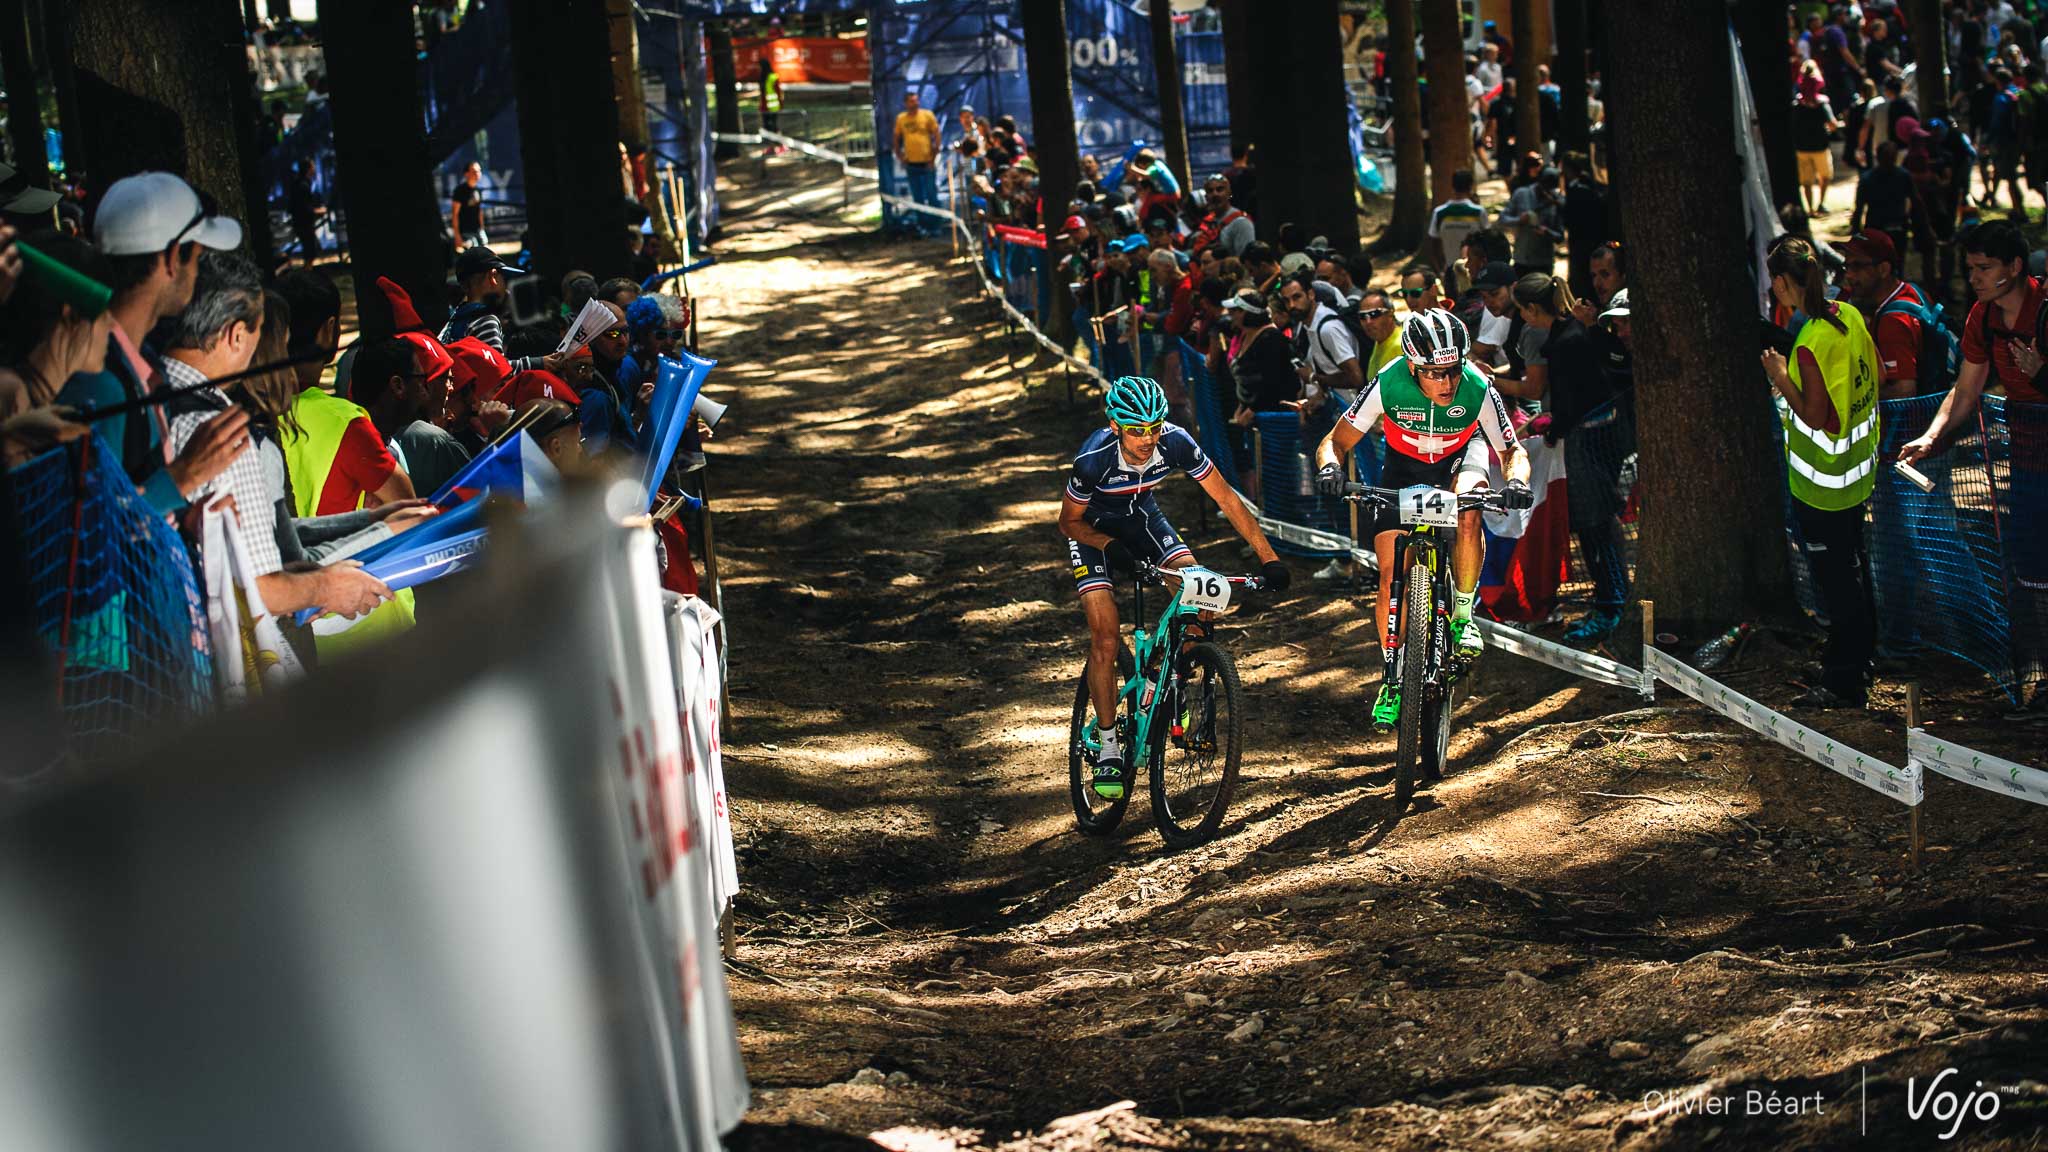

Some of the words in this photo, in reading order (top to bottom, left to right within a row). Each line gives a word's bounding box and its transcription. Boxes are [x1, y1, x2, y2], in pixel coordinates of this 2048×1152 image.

[1412, 492, 1446, 515] 14
[1068, 537, 1083, 567] NCE
[1193, 576, 1221, 598] 16
[1435, 616, 1445, 647] SWISS
